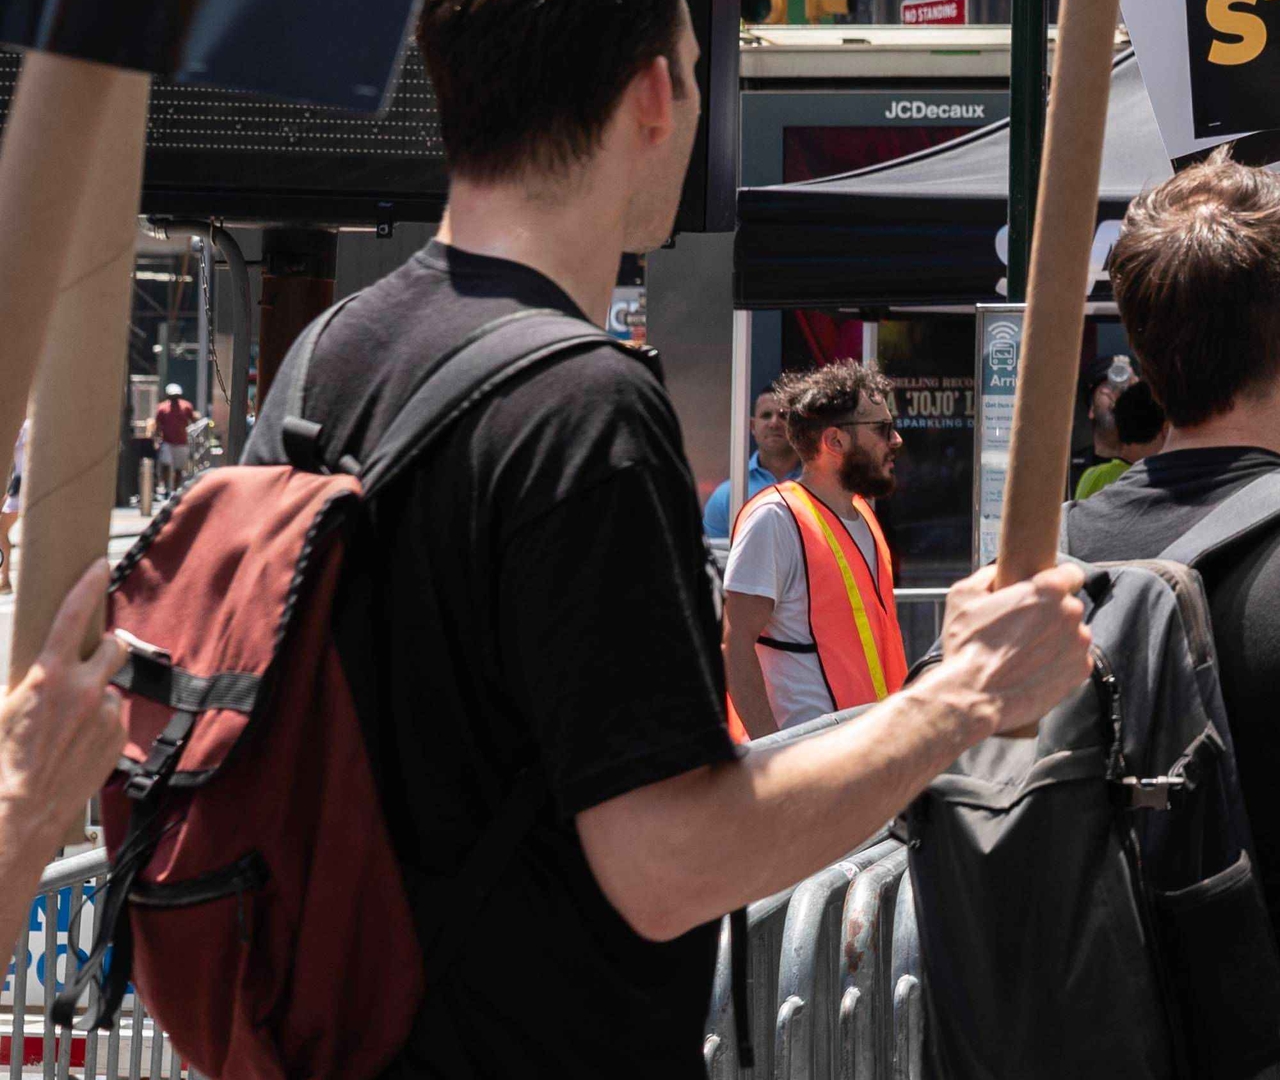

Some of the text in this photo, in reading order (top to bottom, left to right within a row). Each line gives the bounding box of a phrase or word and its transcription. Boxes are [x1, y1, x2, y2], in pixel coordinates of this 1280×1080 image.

[904, 2, 958, 23] NO STANDING
[884, 100, 985, 119] JCDecaux
[896, 418, 962, 428] SPARKLING
